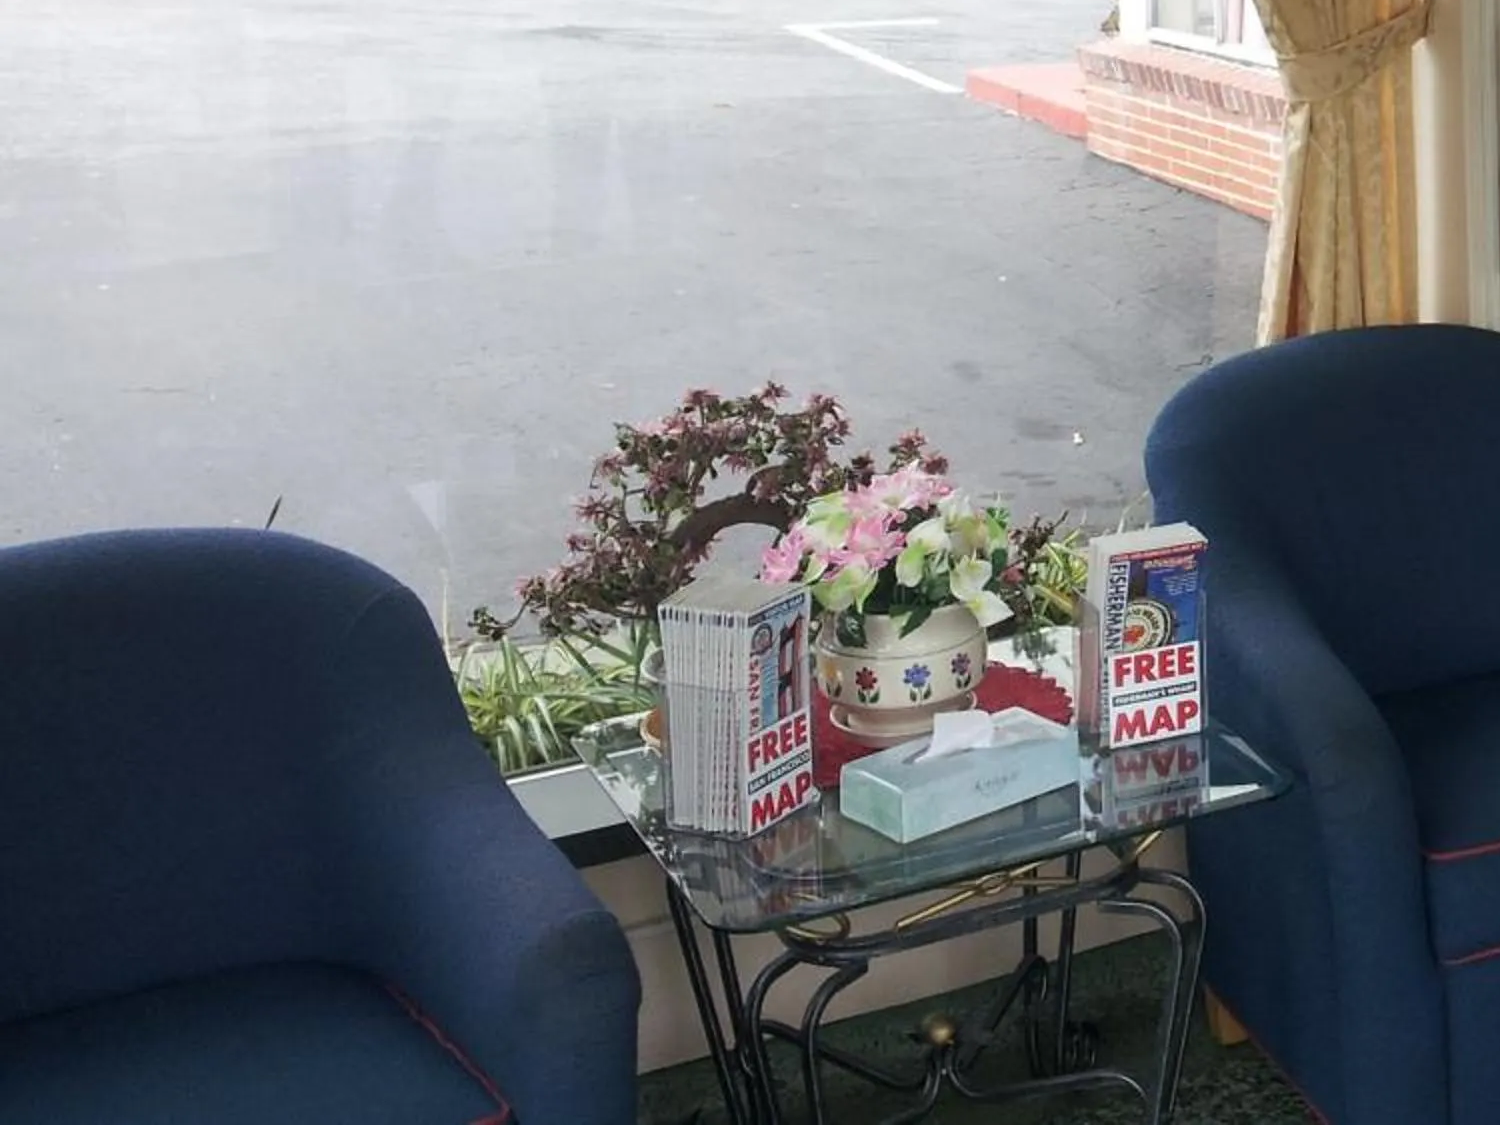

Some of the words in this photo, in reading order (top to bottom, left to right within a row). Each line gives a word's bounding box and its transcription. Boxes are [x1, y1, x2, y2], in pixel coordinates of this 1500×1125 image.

[1105, 564, 1127, 650] FISHERMAN
[1114, 645, 1194, 688] FREE
[749, 713, 808, 773] FREE
[1114, 699, 1198, 743] MAP
[751, 771, 811, 832] MAP
